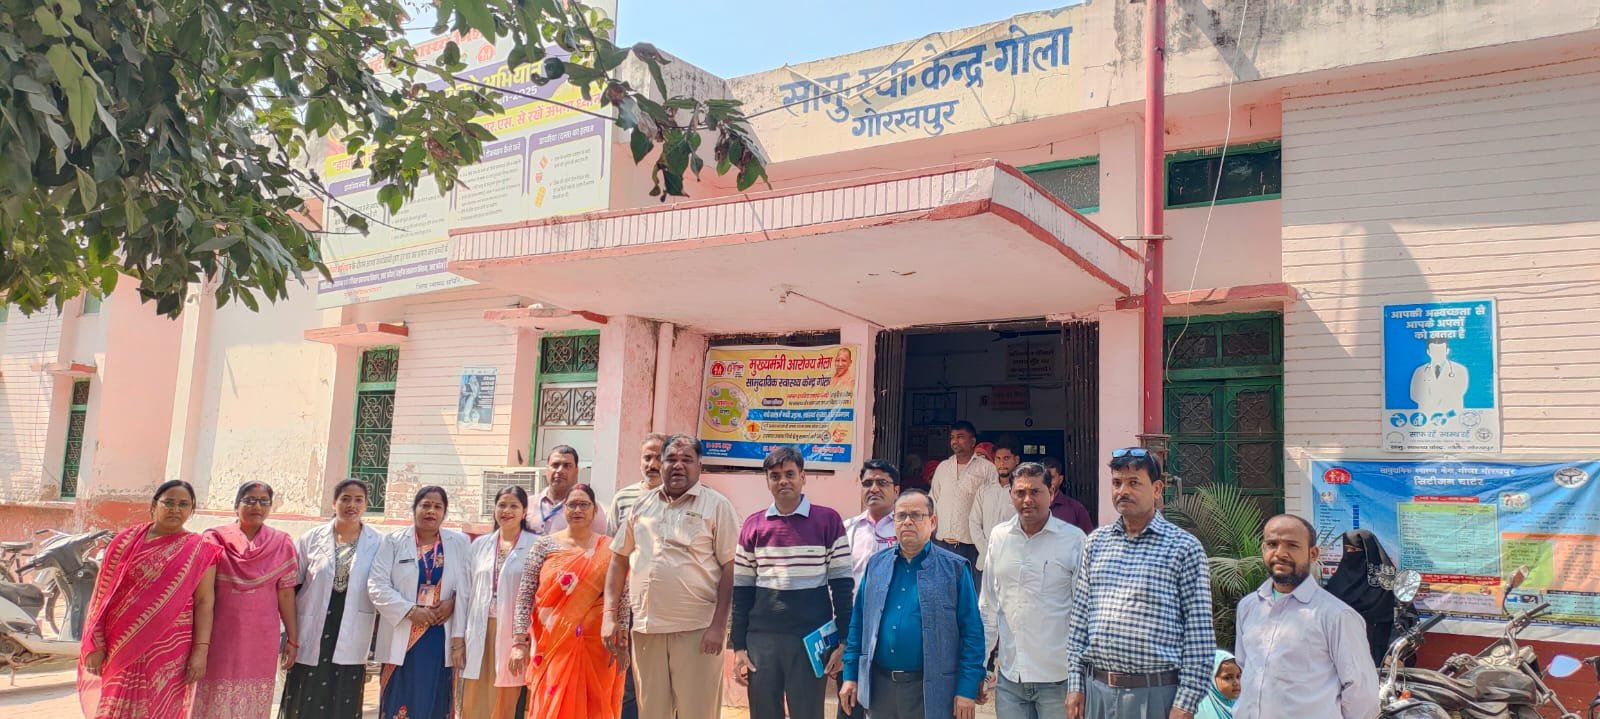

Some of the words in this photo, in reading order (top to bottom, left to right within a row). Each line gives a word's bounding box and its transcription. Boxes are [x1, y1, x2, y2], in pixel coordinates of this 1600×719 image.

[852, 99, 960, 137] गोरखपुर
[1414, 329, 1427, 339] को
[749, 354, 786, 376] मुख्यमंत्री
[787, 355, 817, 370] आरोग्य
